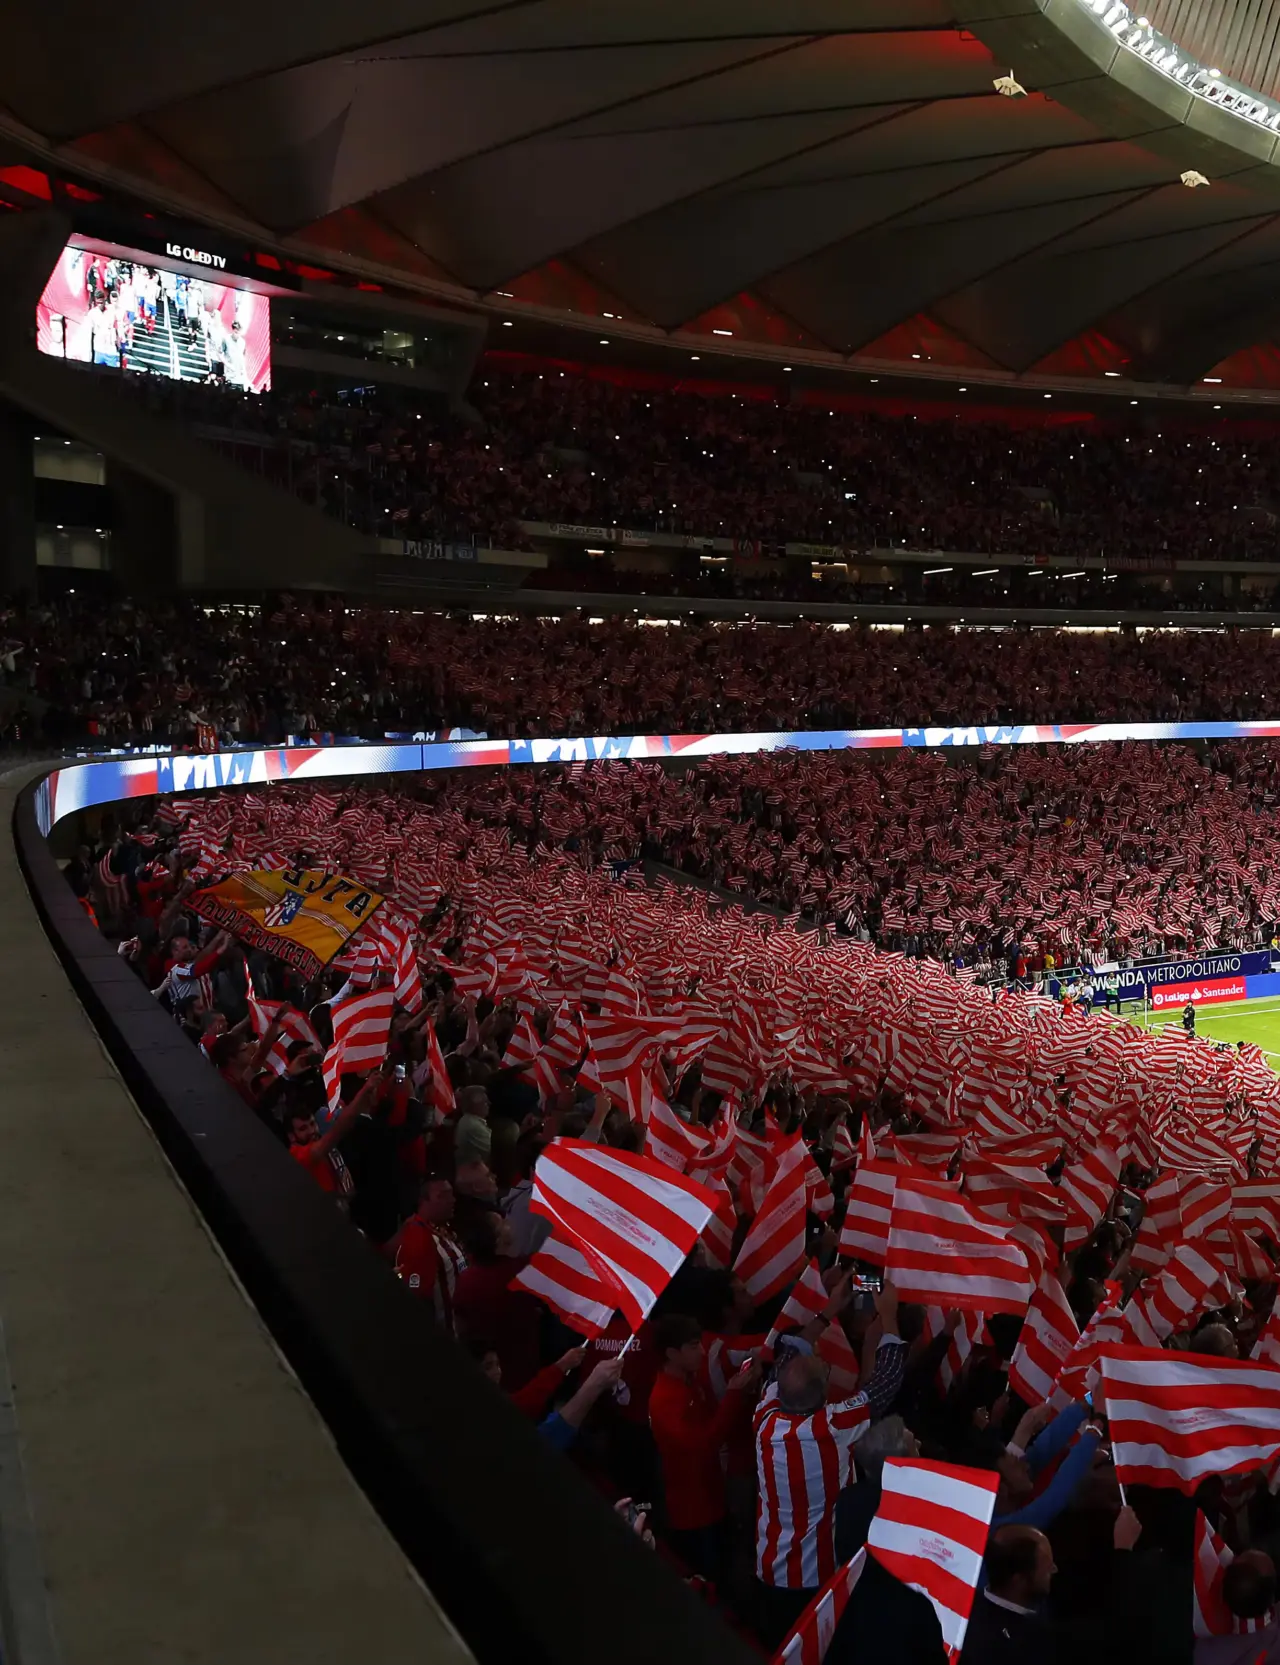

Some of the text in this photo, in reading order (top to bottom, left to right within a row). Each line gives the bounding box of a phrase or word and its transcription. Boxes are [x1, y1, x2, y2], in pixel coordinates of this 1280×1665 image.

[166, 243, 226, 268] LG OLED TV
[1092, 957, 1241, 992] WNDA METROPOLITANO
[1165, 984, 1245, 1002] LaLiga Santander
